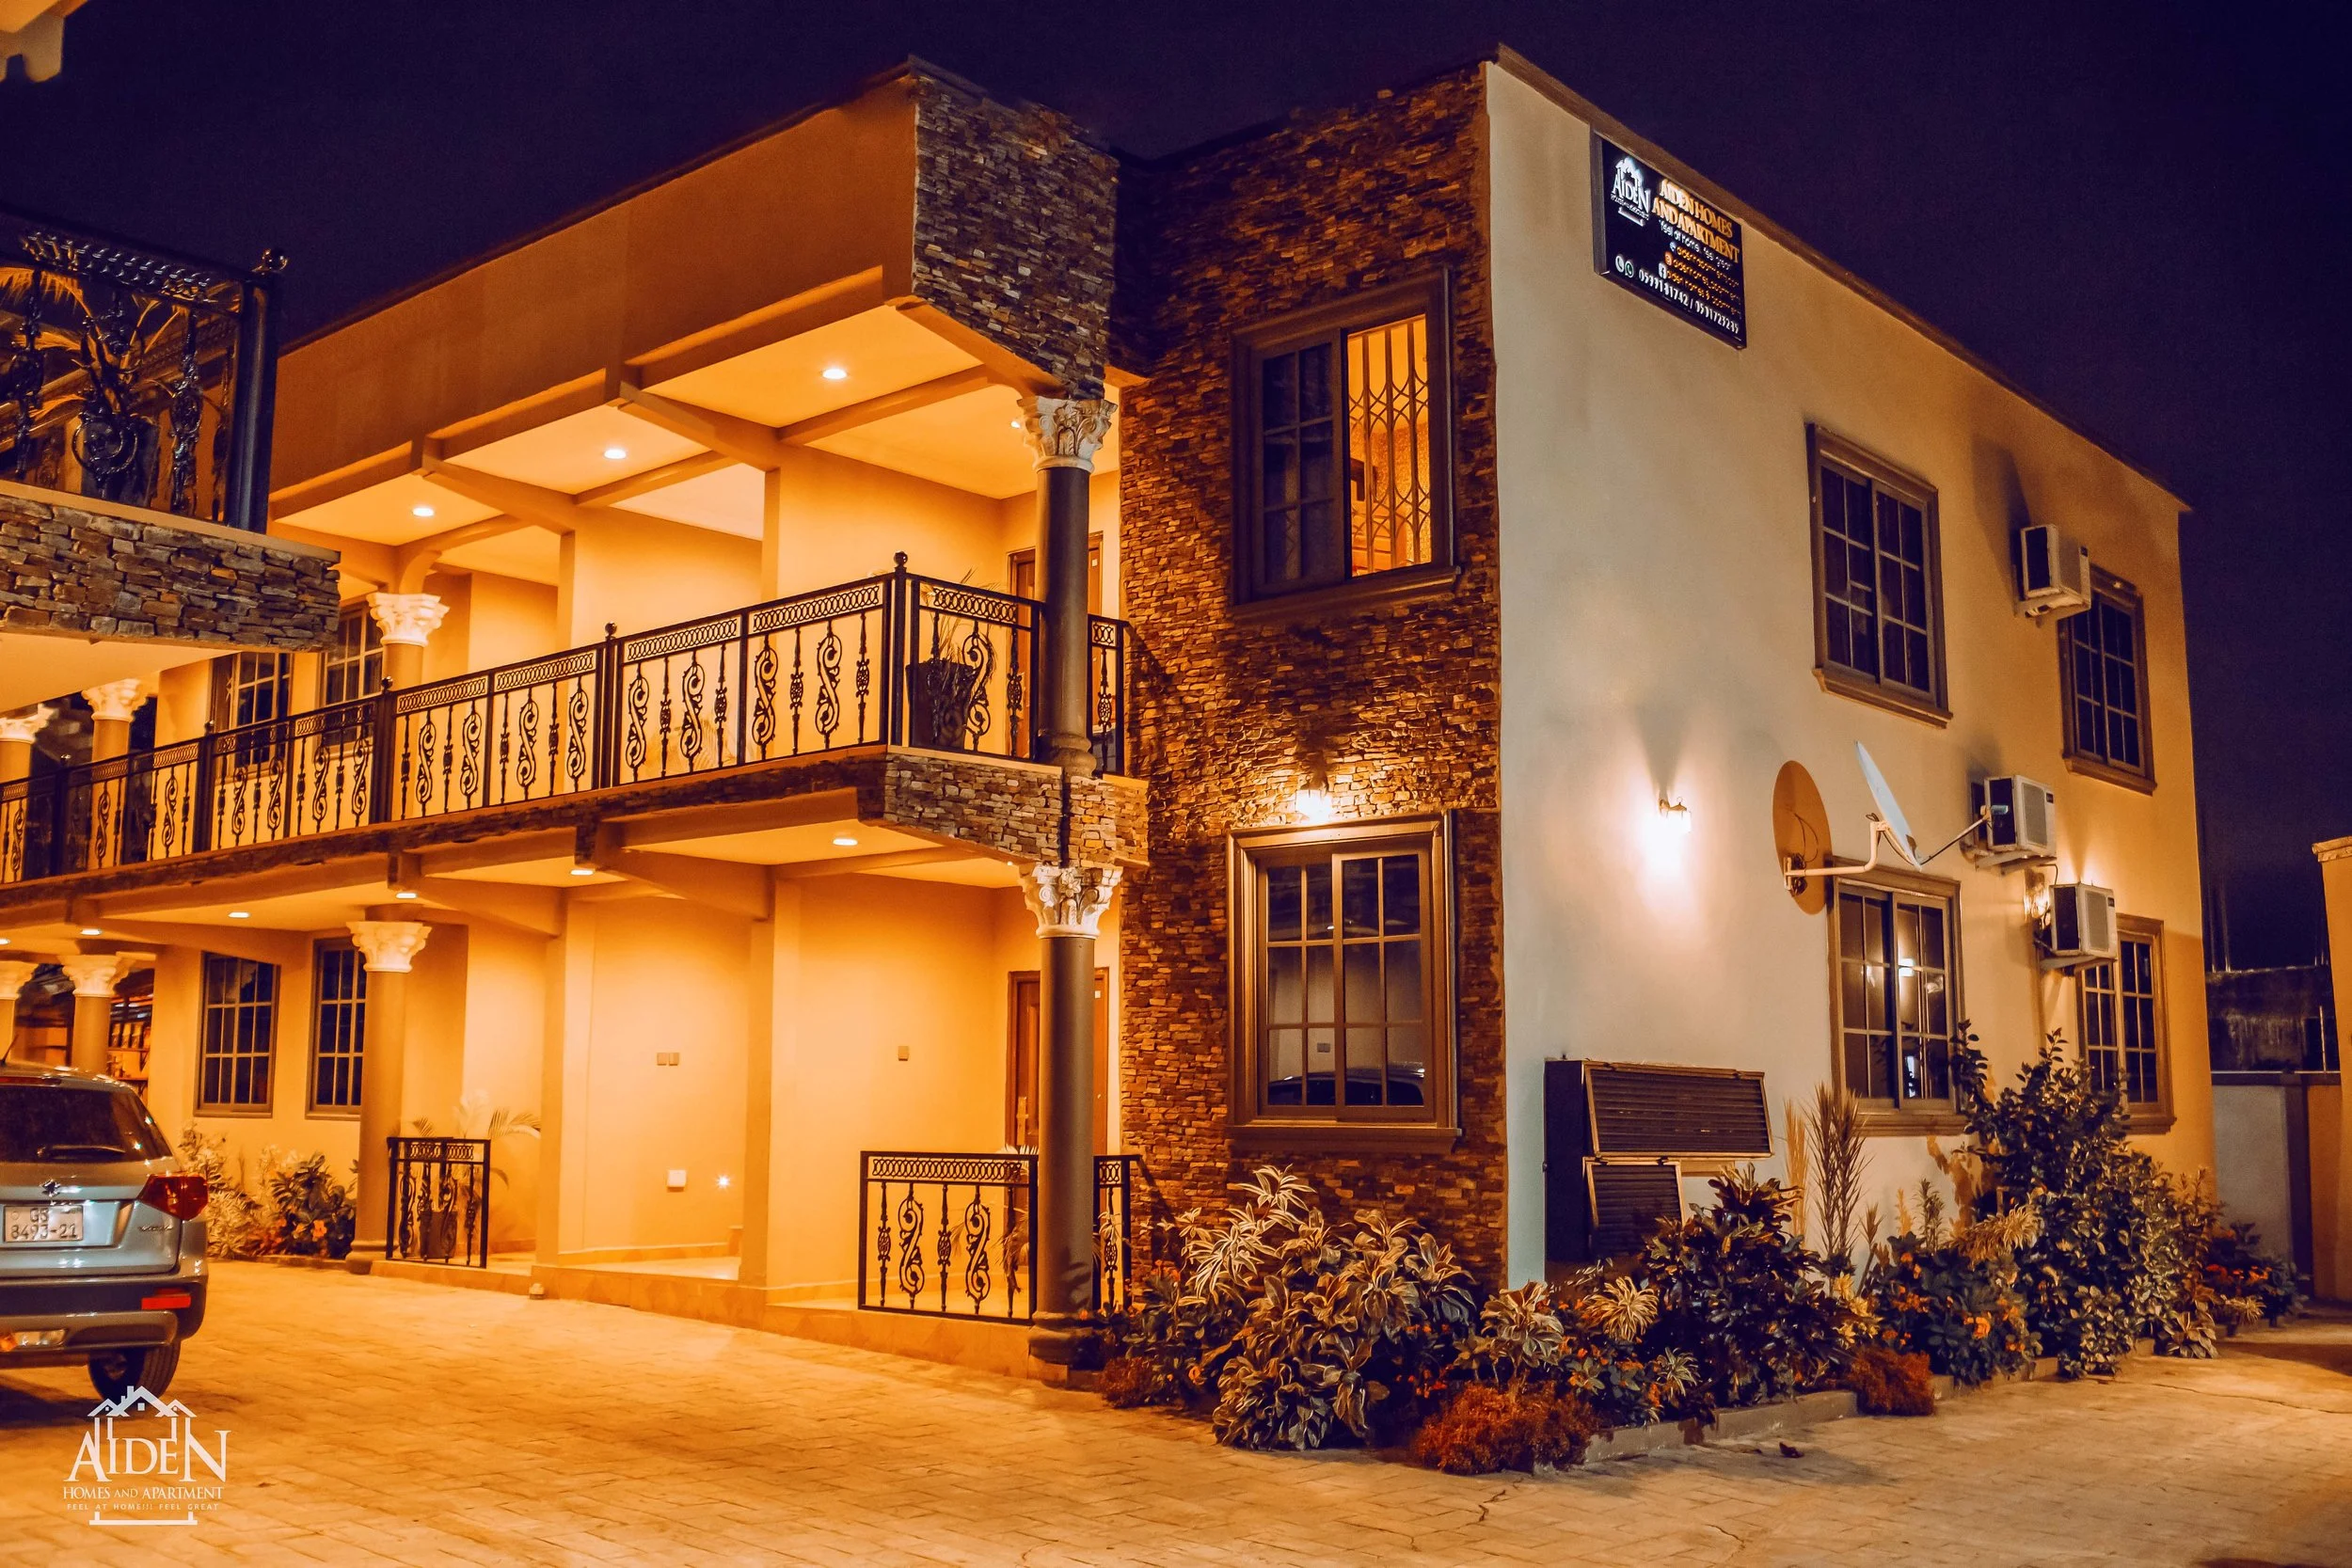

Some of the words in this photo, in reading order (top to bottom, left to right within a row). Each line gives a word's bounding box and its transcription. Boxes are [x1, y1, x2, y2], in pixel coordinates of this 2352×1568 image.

[1612, 171, 1651, 214] AIDEN
[1660, 179, 1694, 215] AIDEN
[1694, 201, 1733, 238] HOMES
[1652, 197, 1678, 225] AND
[1677, 213, 1740, 263] APARTMENT
